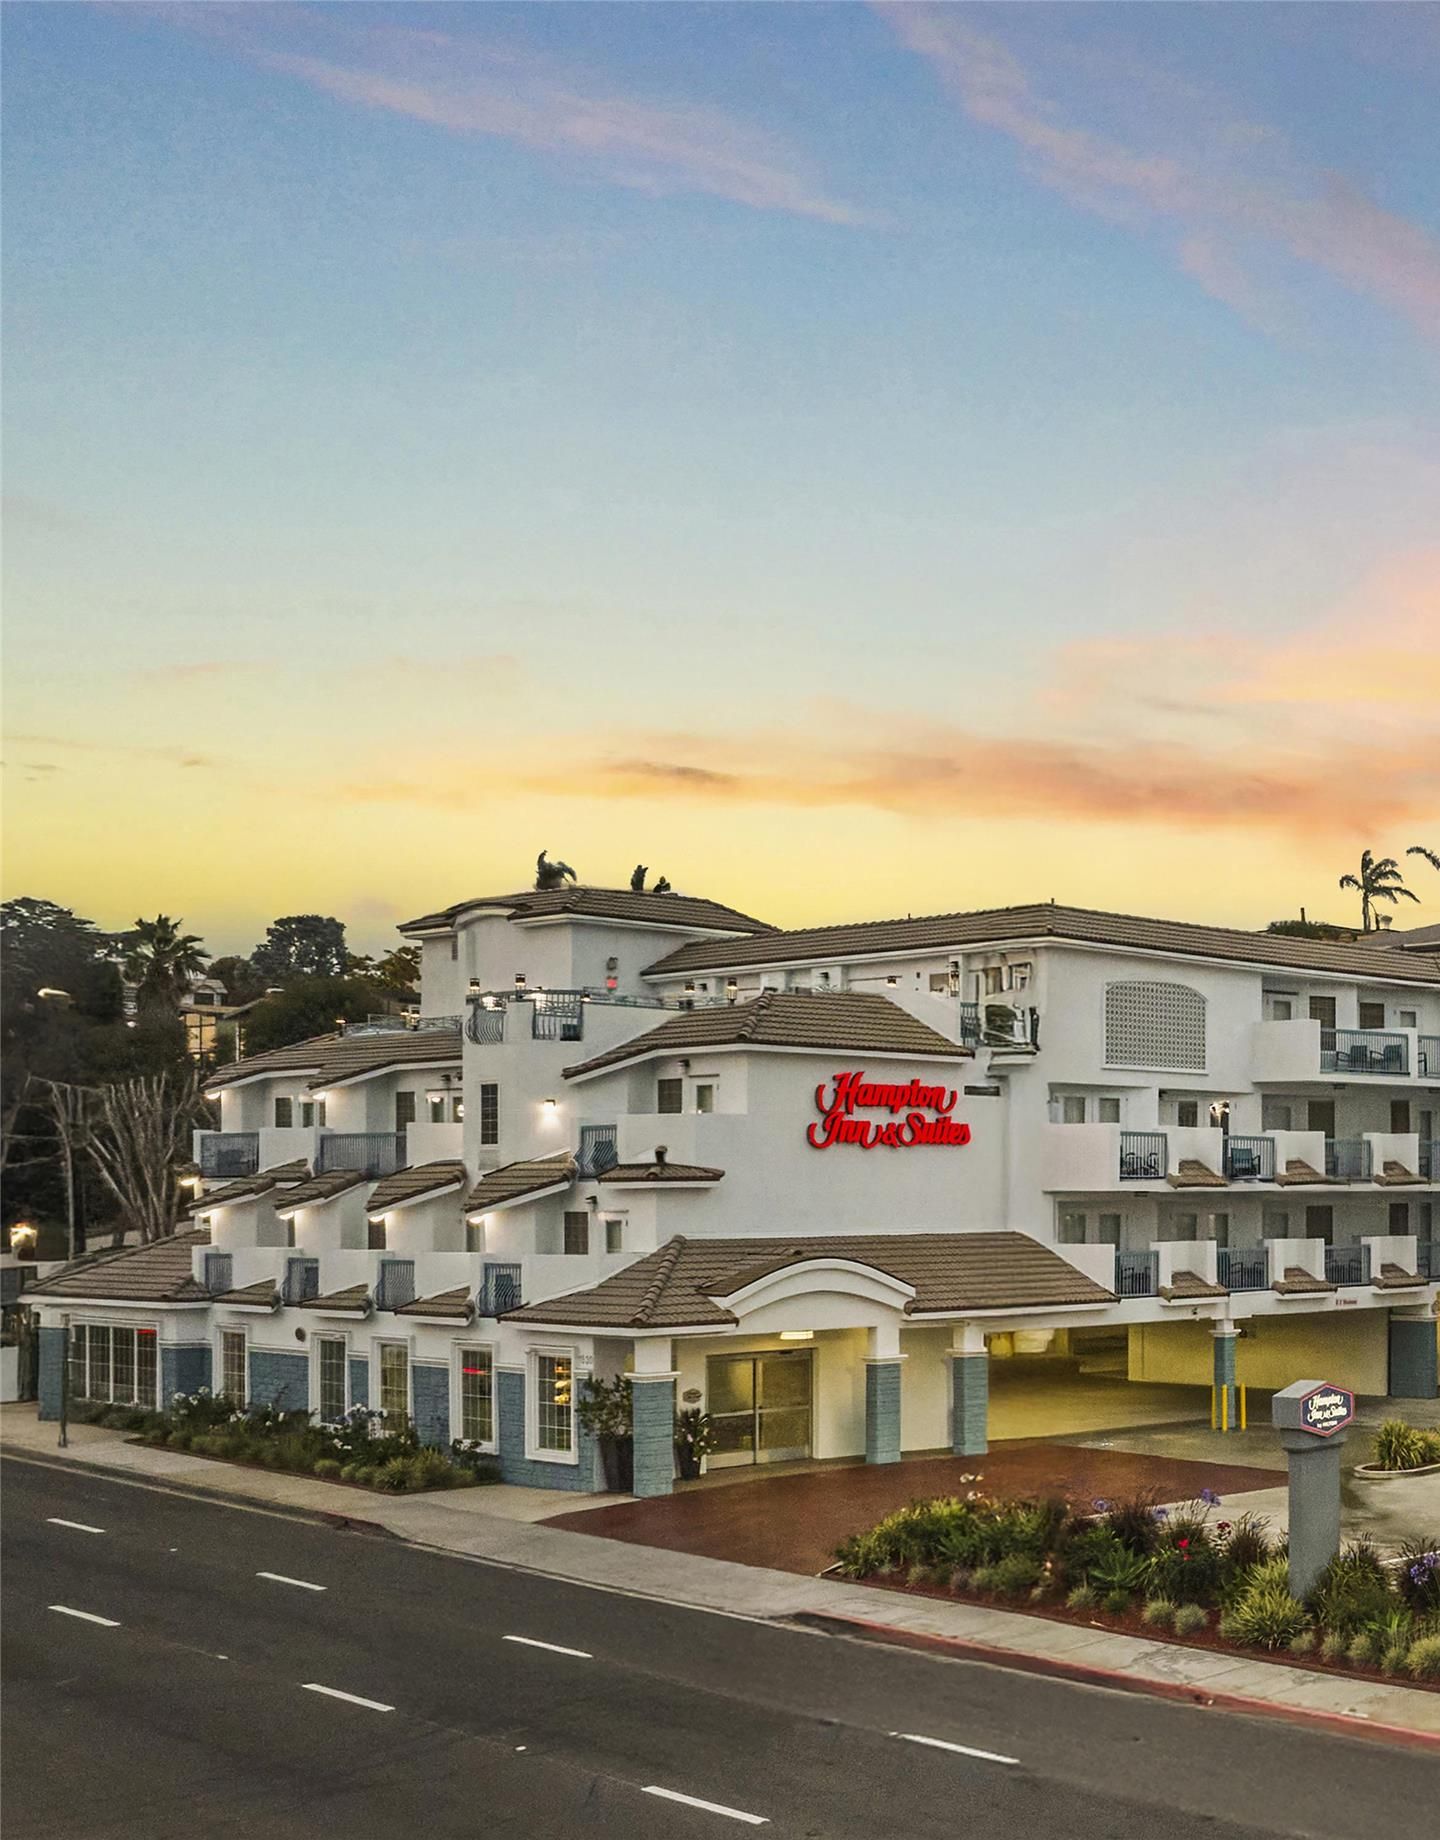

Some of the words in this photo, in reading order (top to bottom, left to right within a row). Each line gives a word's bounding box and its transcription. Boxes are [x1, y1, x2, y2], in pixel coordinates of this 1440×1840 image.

[815, 1071, 958, 1115] Hampton
[807, 1111, 884, 1149] Inn
[881, 1122, 901, 1149] &
[896, 1112, 972, 1147] Suites
